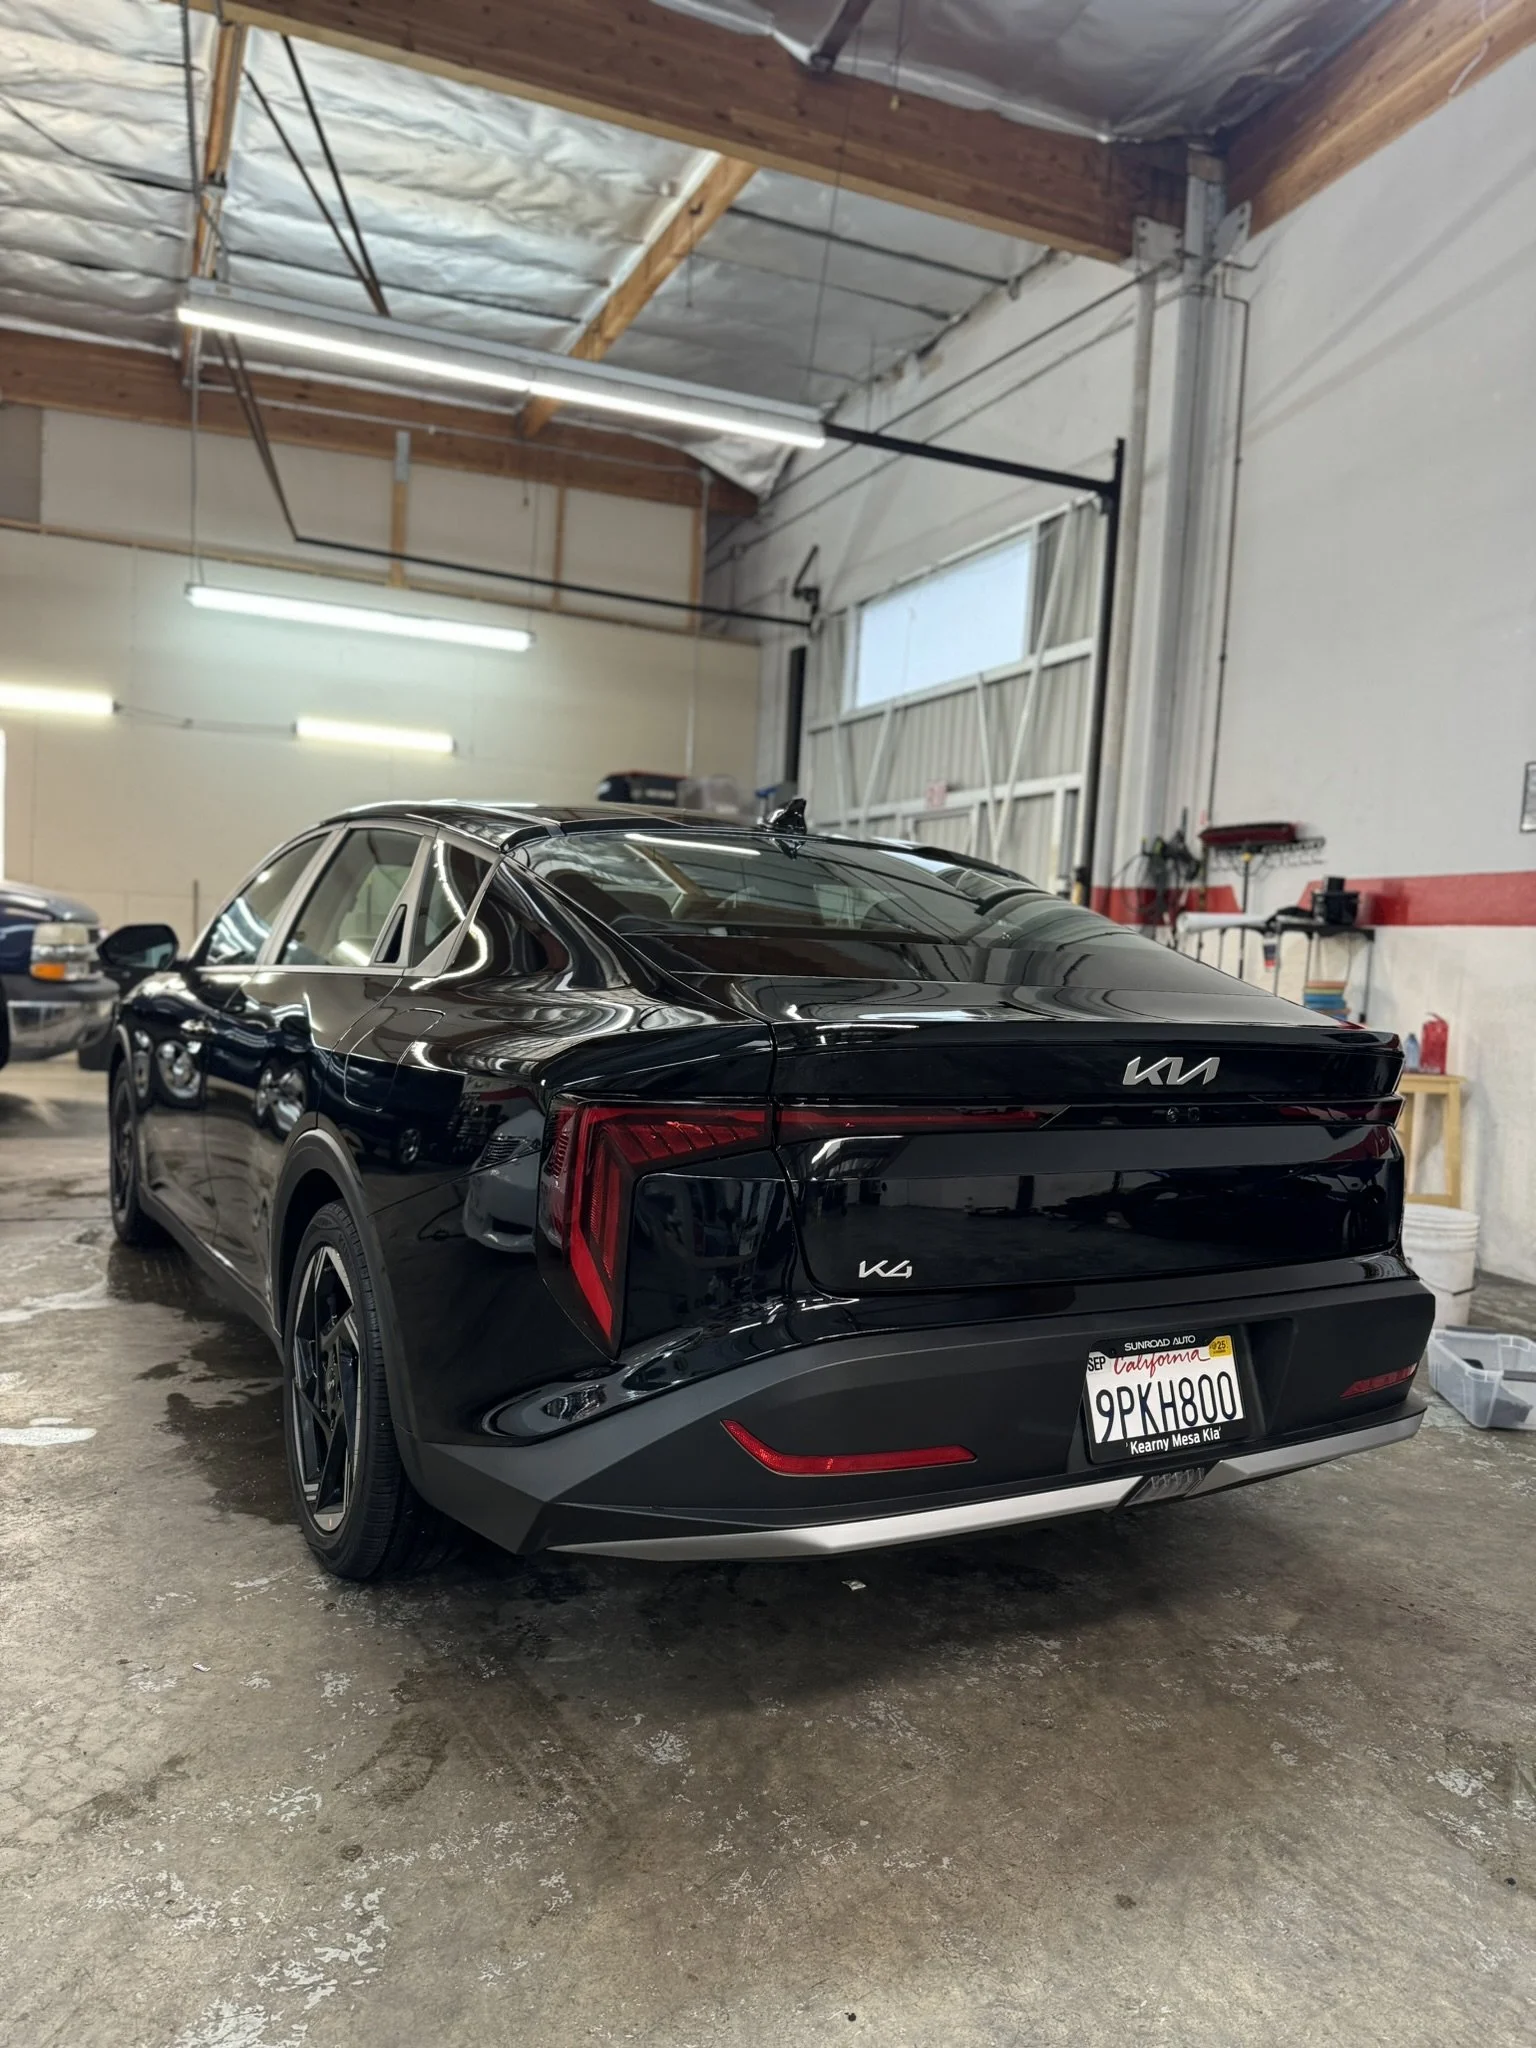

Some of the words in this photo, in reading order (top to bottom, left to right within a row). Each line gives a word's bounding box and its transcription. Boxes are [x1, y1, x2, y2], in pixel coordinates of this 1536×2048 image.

[859, 1260, 912, 1279] K4
[1124, 1338, 1170, 1352] SUNROAD
[1172, 1335, 1196, 1346] AUTO
[1088, 1356, 1106, 1372] SEP
[1114, 1349, 1211, 1378] California
[1096, 1371, 1237, 1443] 9PKH800
[1130, 1438, 1169, 1455] Kearny
[1172, 1433, 1200, 1447] Mesa
[1203, 1427, 1220, 1442] Kia
